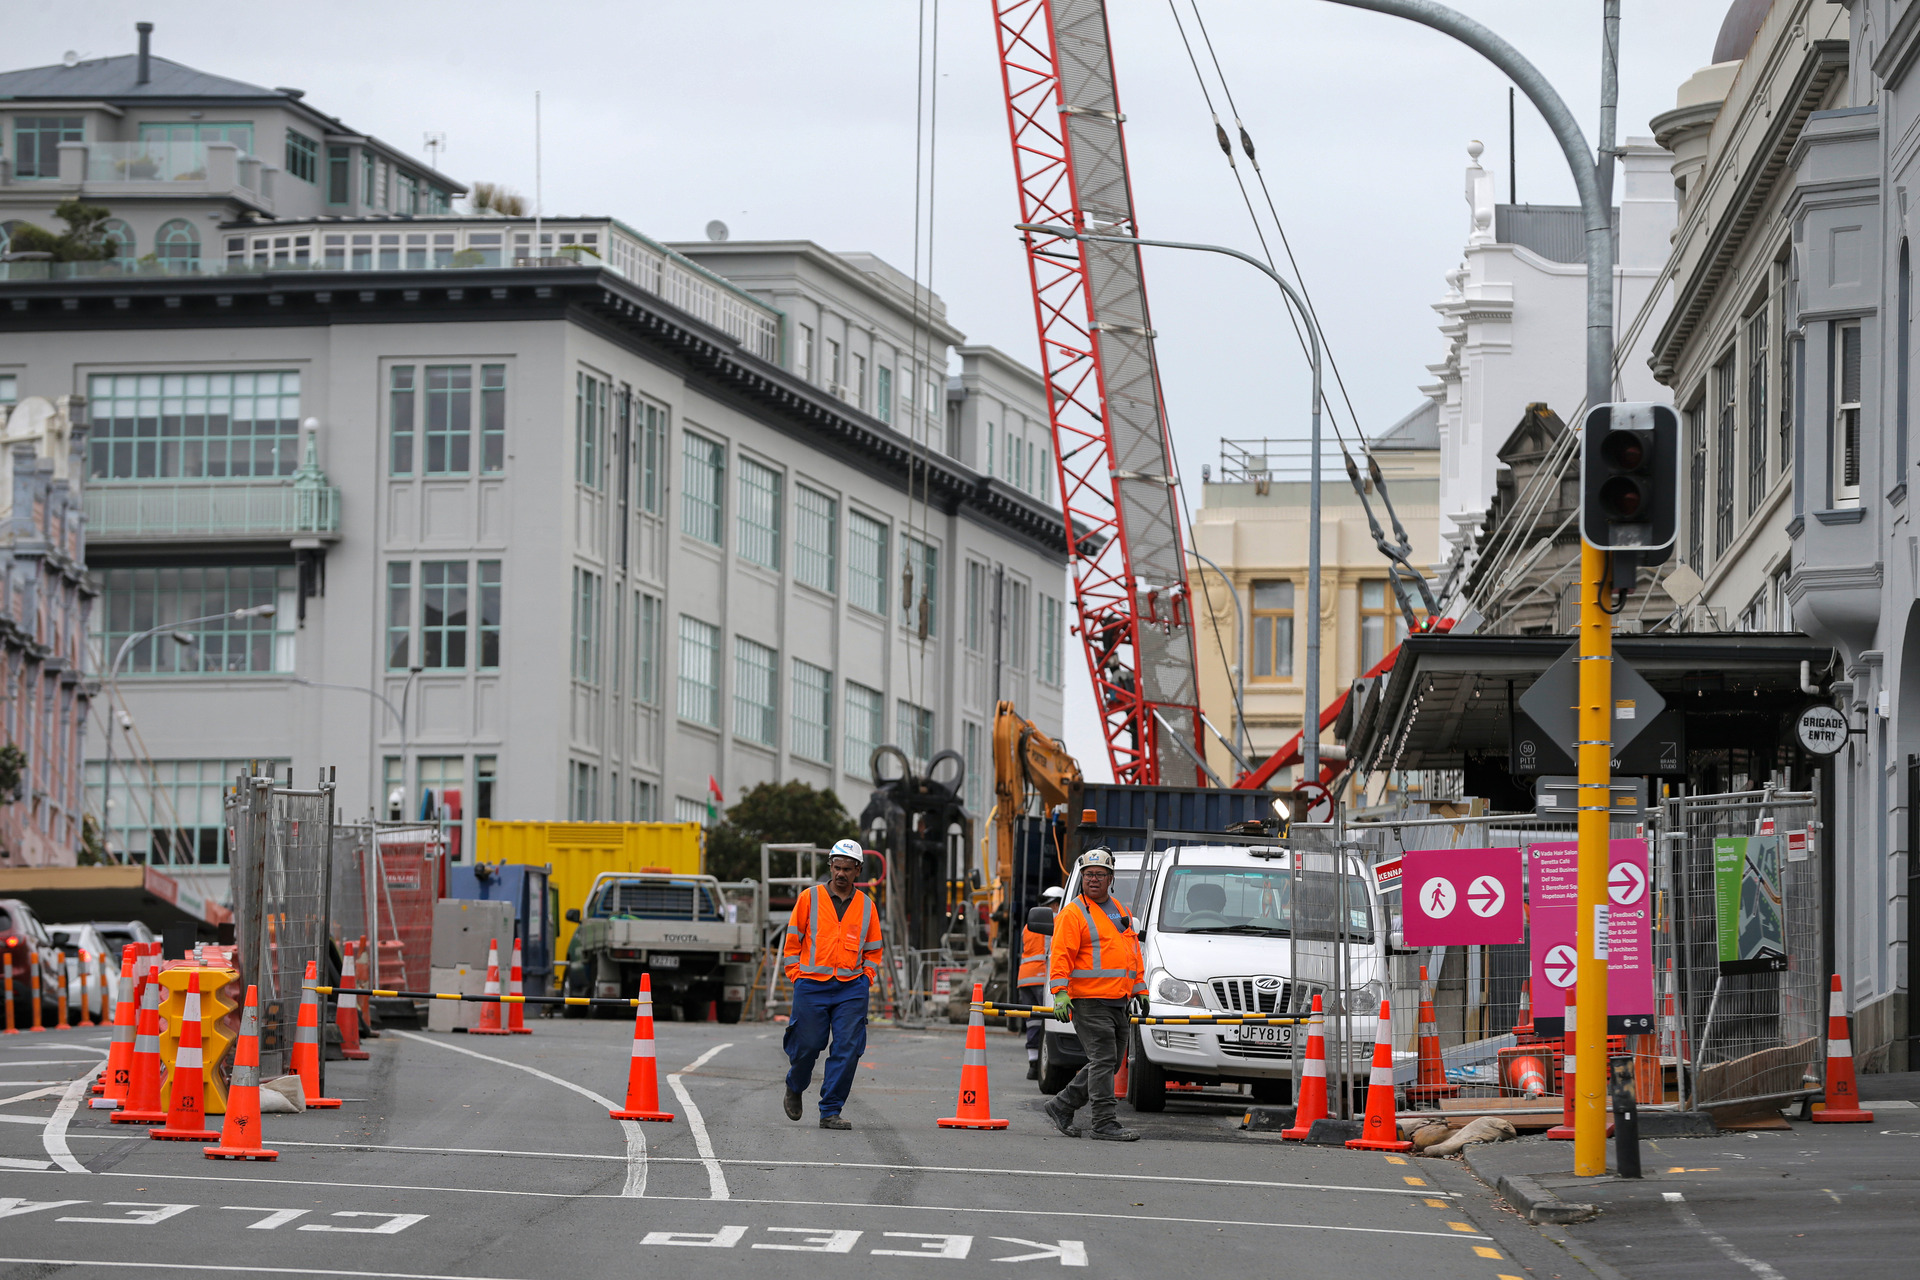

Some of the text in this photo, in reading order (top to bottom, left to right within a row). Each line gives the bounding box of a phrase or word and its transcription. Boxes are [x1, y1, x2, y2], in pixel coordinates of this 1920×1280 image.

[1803, 717, 1843, 728] BRIGADE
[1808, 730, 1836, 741] ENTRY
[1523, 744, 1533, 753] 59
[1378, 867, 1402, 881] KENNA
[664, 934, 698, 942] TOYOTA
[1242, 1026, 1291, 1041] JFY819
[0, 1197, 1089, 1266] KEEP CLEA
